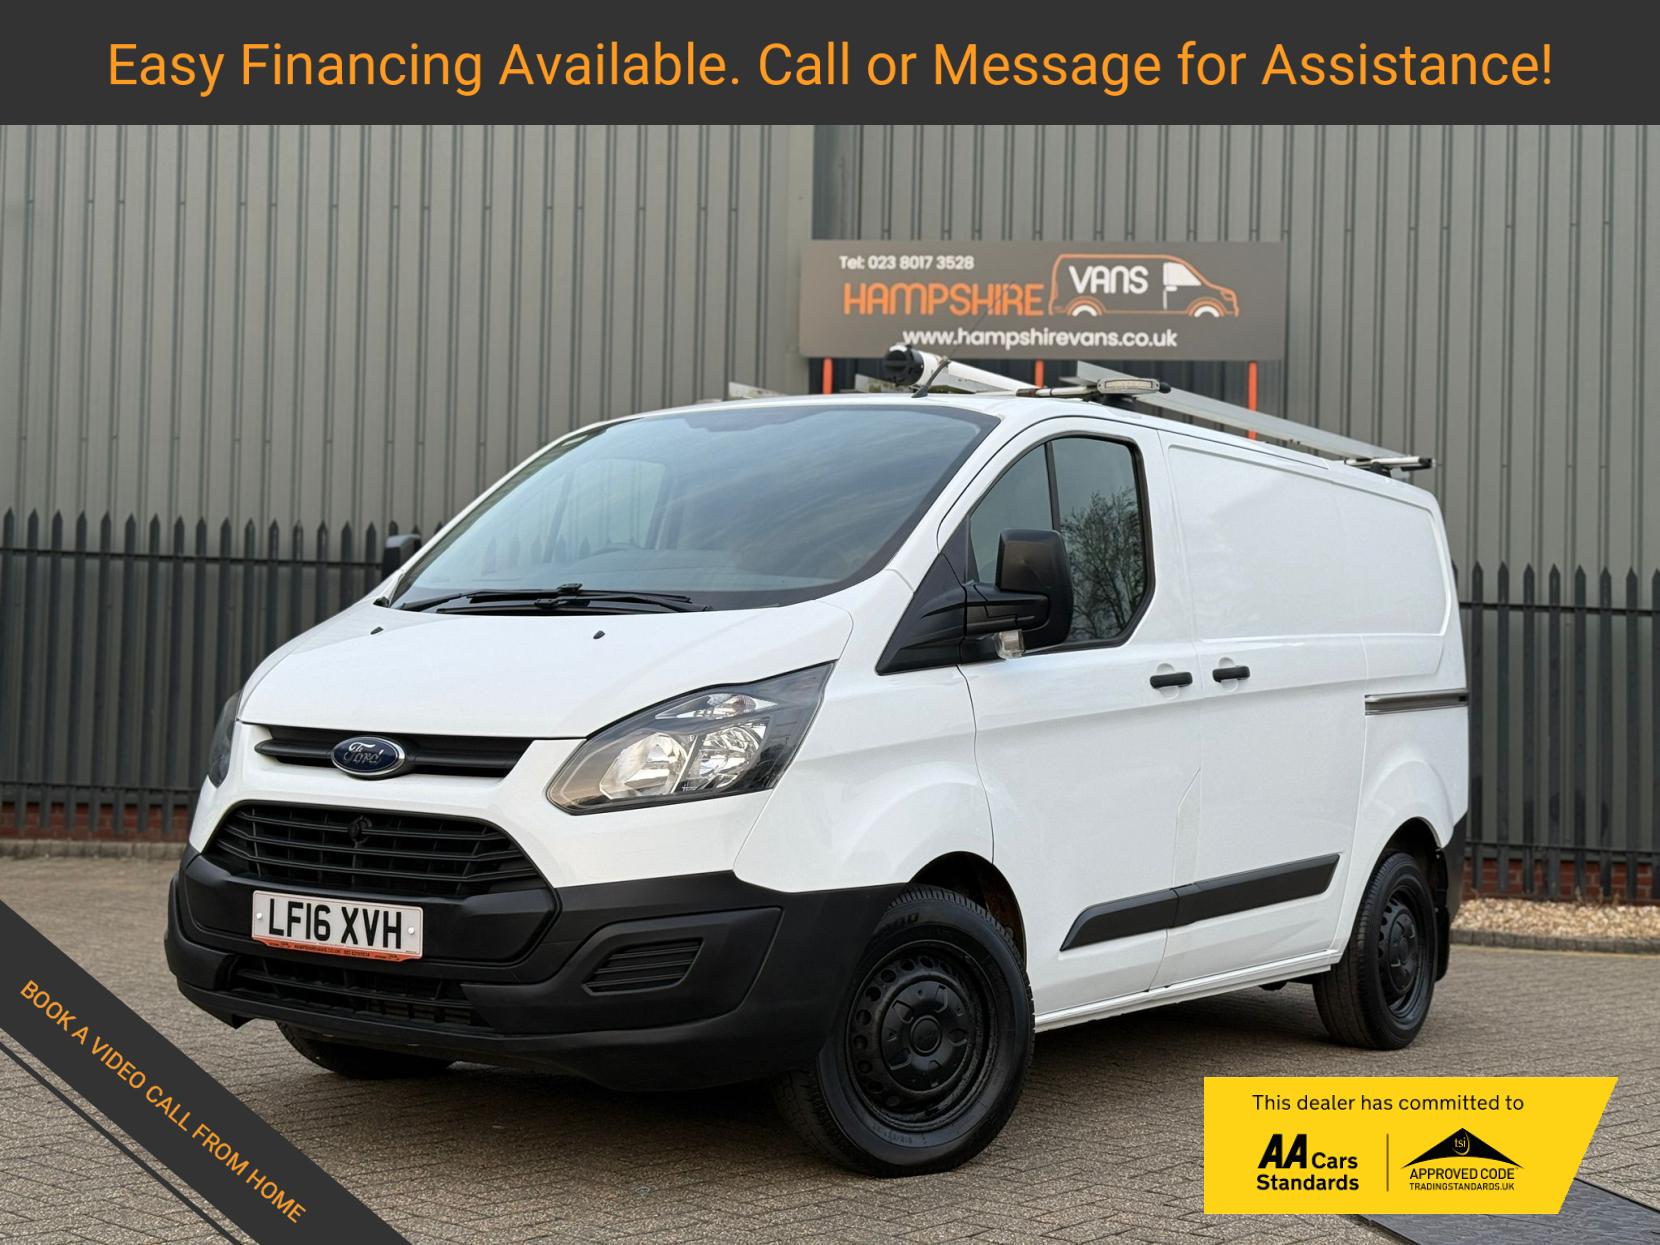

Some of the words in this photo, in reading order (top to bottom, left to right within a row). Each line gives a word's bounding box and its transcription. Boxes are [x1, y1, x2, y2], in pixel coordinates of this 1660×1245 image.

[839, 255, 866, 270] Tel:
[867, 255, 897, 270] 023
[899, 255, 934, 270] 8017
[936, 255, 975, 270] 3528
[1068, 265, 1149, 295] VANS
[842, 281, 1045, 318] HAMPSHIRE
[902, 327, 1178, 351] www.hampshirevans.co.uk
[343, 741, 385, 764] Ford
[268, 897, 331, 942] LF16
[340, 906, 403, 950] XVH
